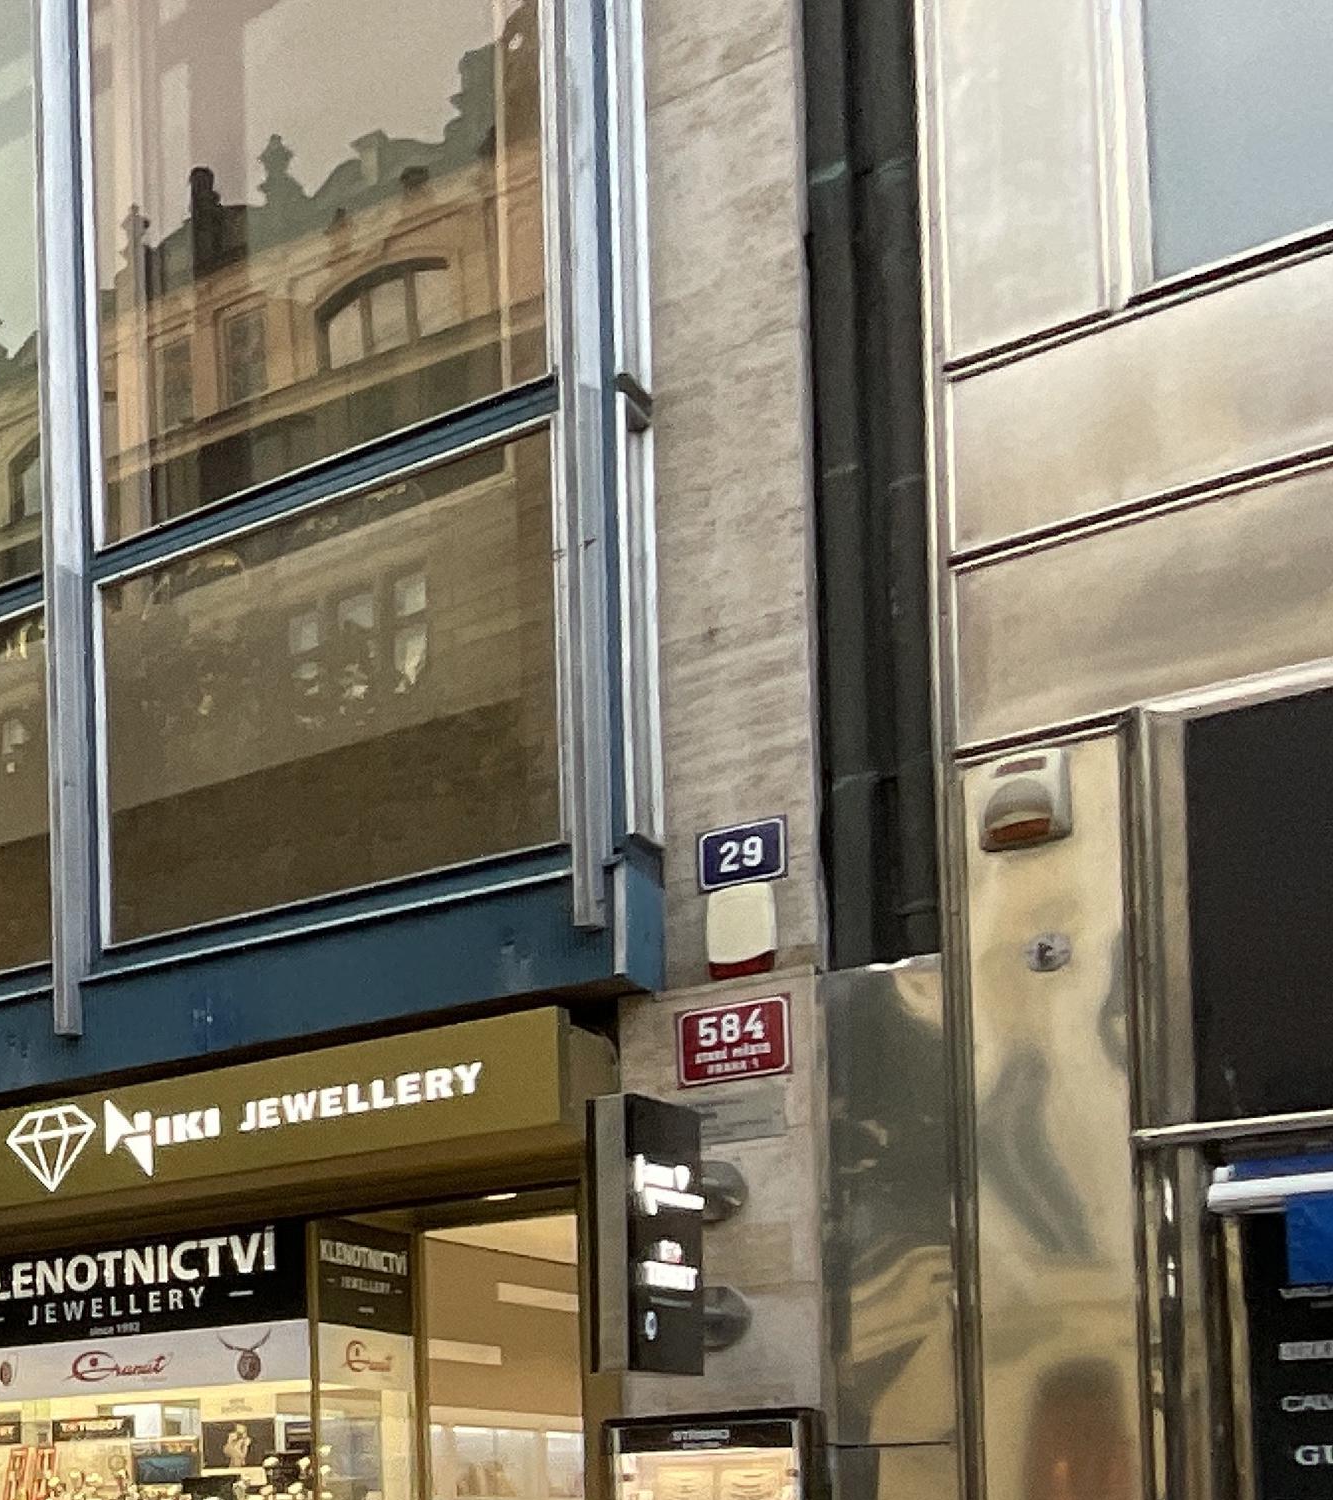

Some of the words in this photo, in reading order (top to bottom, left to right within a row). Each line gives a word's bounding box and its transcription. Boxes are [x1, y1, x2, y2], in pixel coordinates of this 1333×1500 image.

[718, 835, 764, 873] 29
[697, 1005, 765, 1047] 584
[238, 1060, 483, 1133] JEWELLERY
[28, 1285, 207, 1326] JEWELLERY
